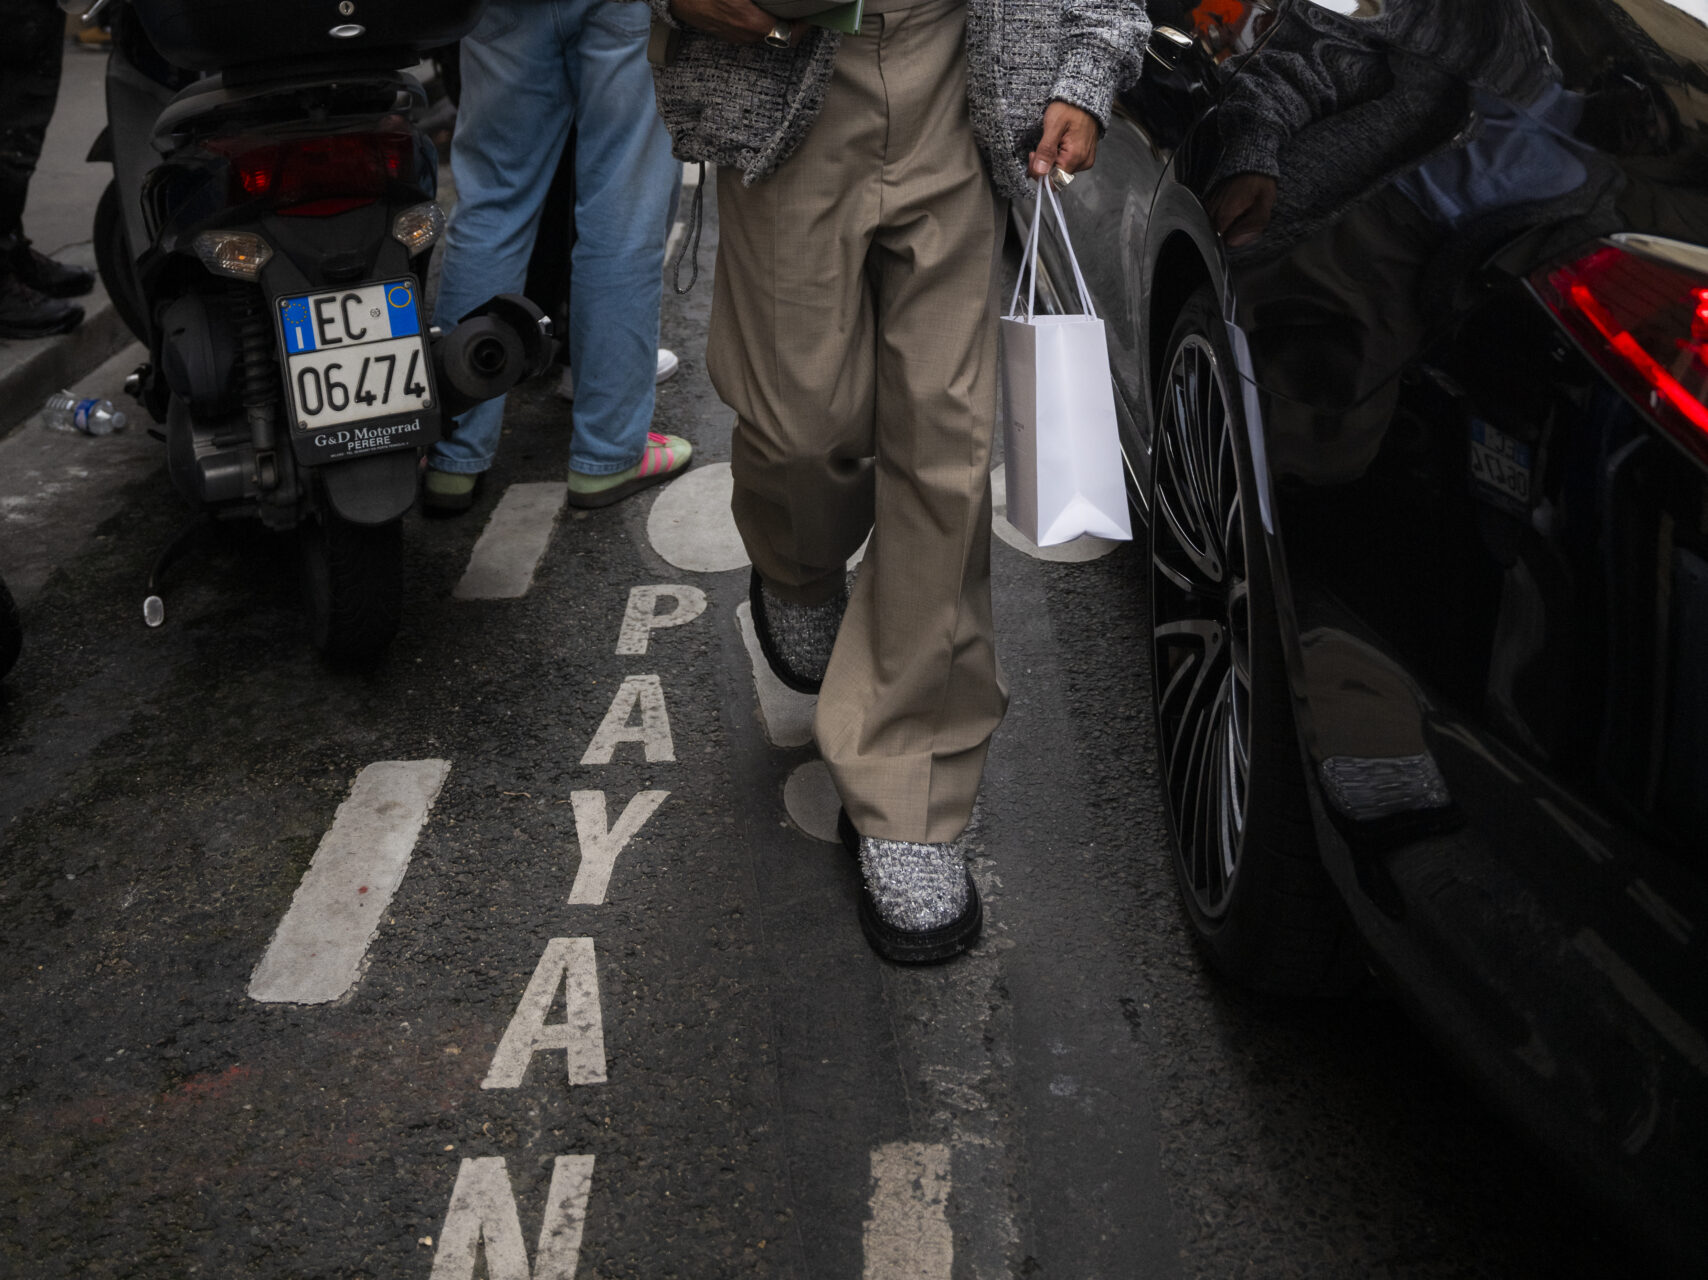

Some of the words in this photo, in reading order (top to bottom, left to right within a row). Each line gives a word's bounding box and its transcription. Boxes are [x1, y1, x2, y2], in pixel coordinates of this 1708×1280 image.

[313, 292, 367, 345] EC
[297, 349, 426, 416] 06474
[314, 431, 350, 447] G&D
[354, 418, 420, 440] Motorrad
[347, 436, 391, 451] PERERE
